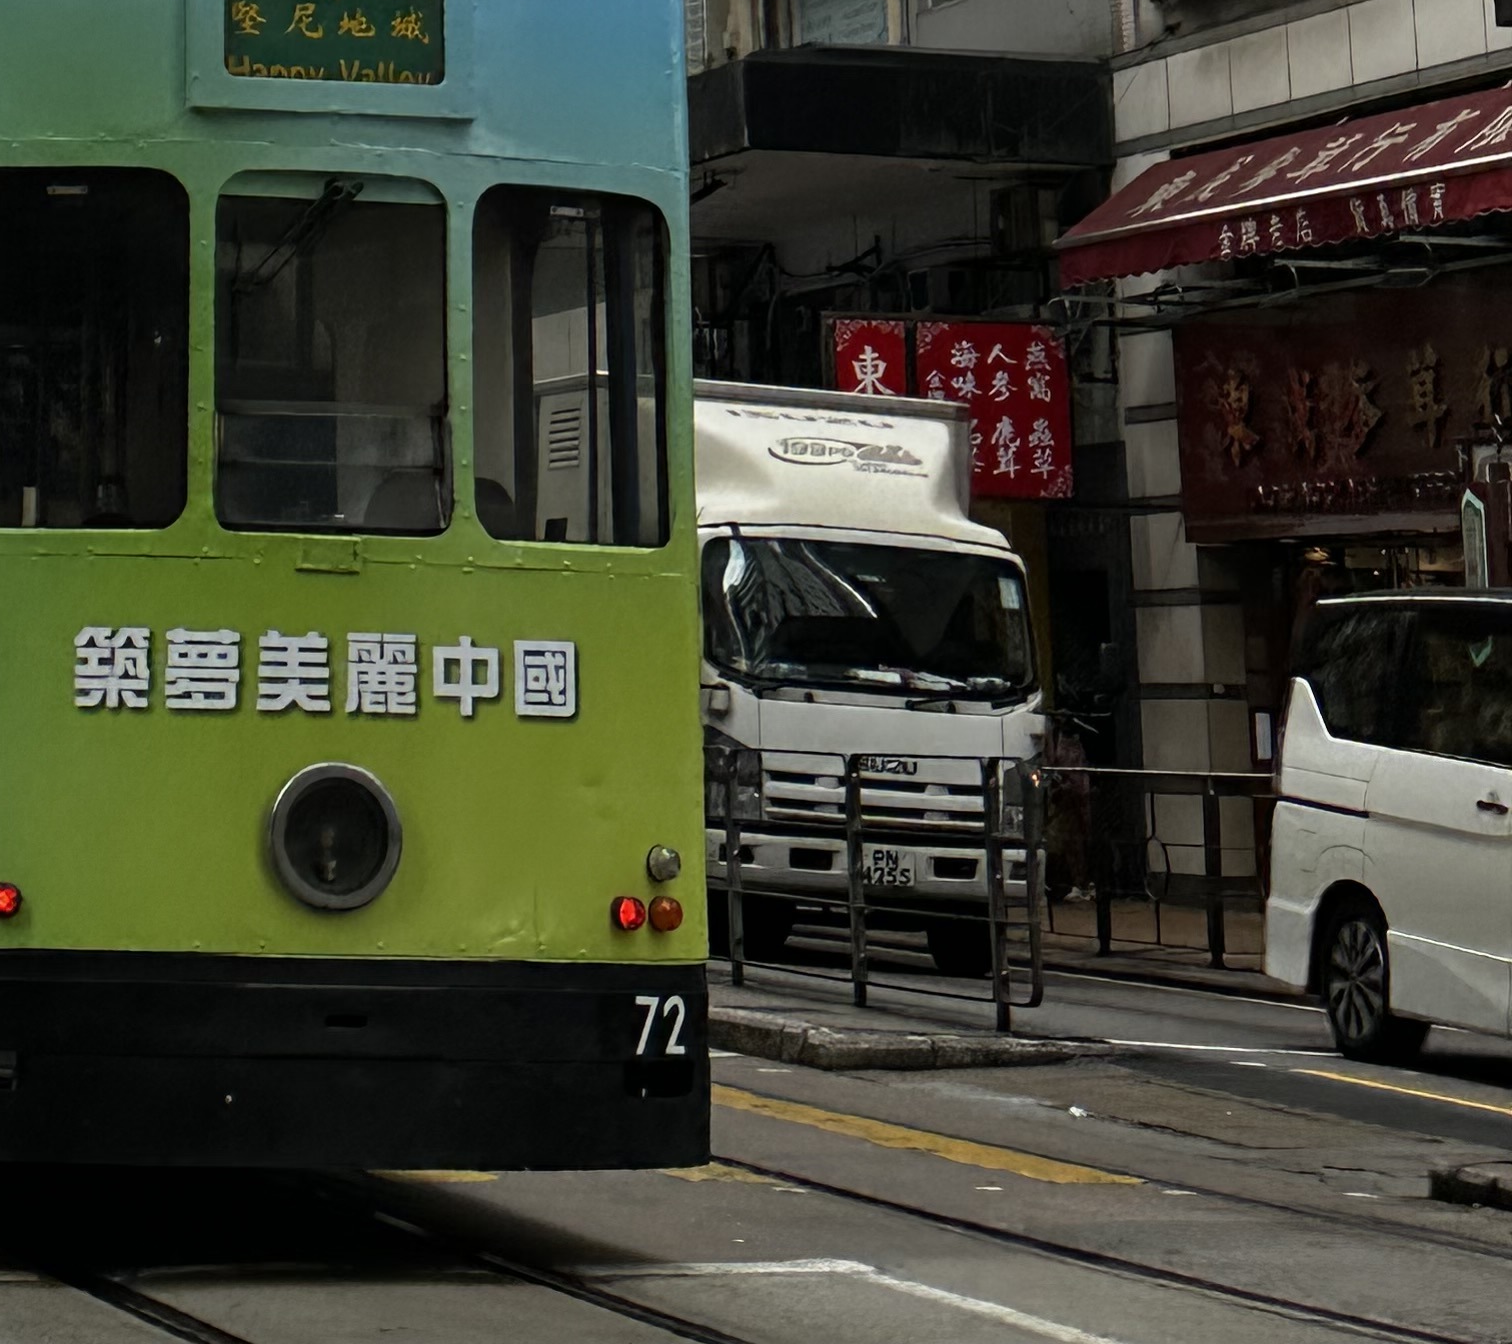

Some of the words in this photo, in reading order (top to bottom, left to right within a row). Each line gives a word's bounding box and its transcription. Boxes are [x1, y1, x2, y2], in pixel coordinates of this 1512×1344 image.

[231, 0, 430, 45] 堅尼地城
[852, 345, 897, 395] 東
[950, 340, 983, 399] 海味
[988, 343, 1019, 402] 人參
[73, 626, 580, 718] 築夢美麗中國
[858, 756, 918, 776] SUZU
[635, 994, 686, 1056] 72
